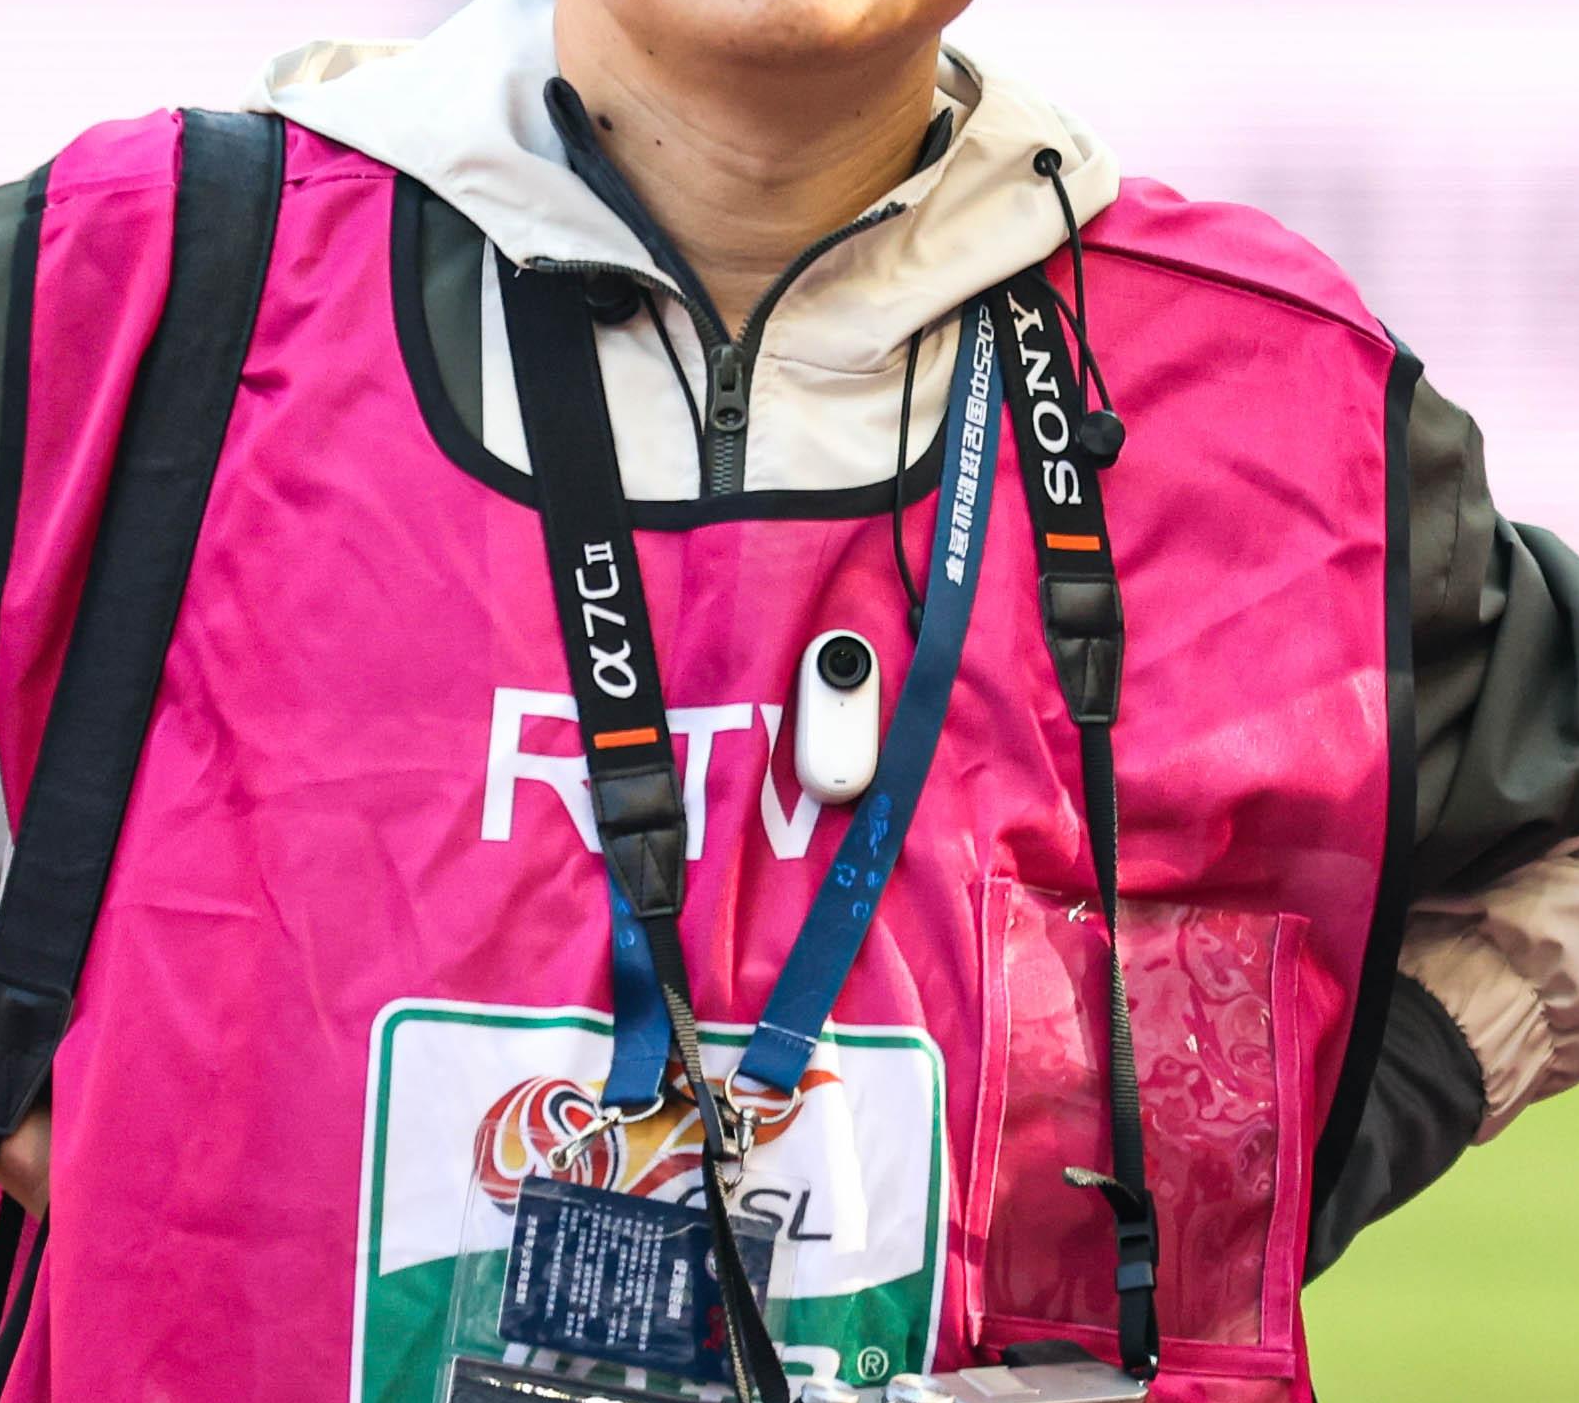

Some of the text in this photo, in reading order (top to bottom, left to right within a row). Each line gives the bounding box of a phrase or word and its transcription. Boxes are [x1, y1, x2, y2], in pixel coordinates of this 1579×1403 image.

[945, 303, 995, 587] 2025中国足球职业赛事
[1007, 291, 1082, 505] SONY
